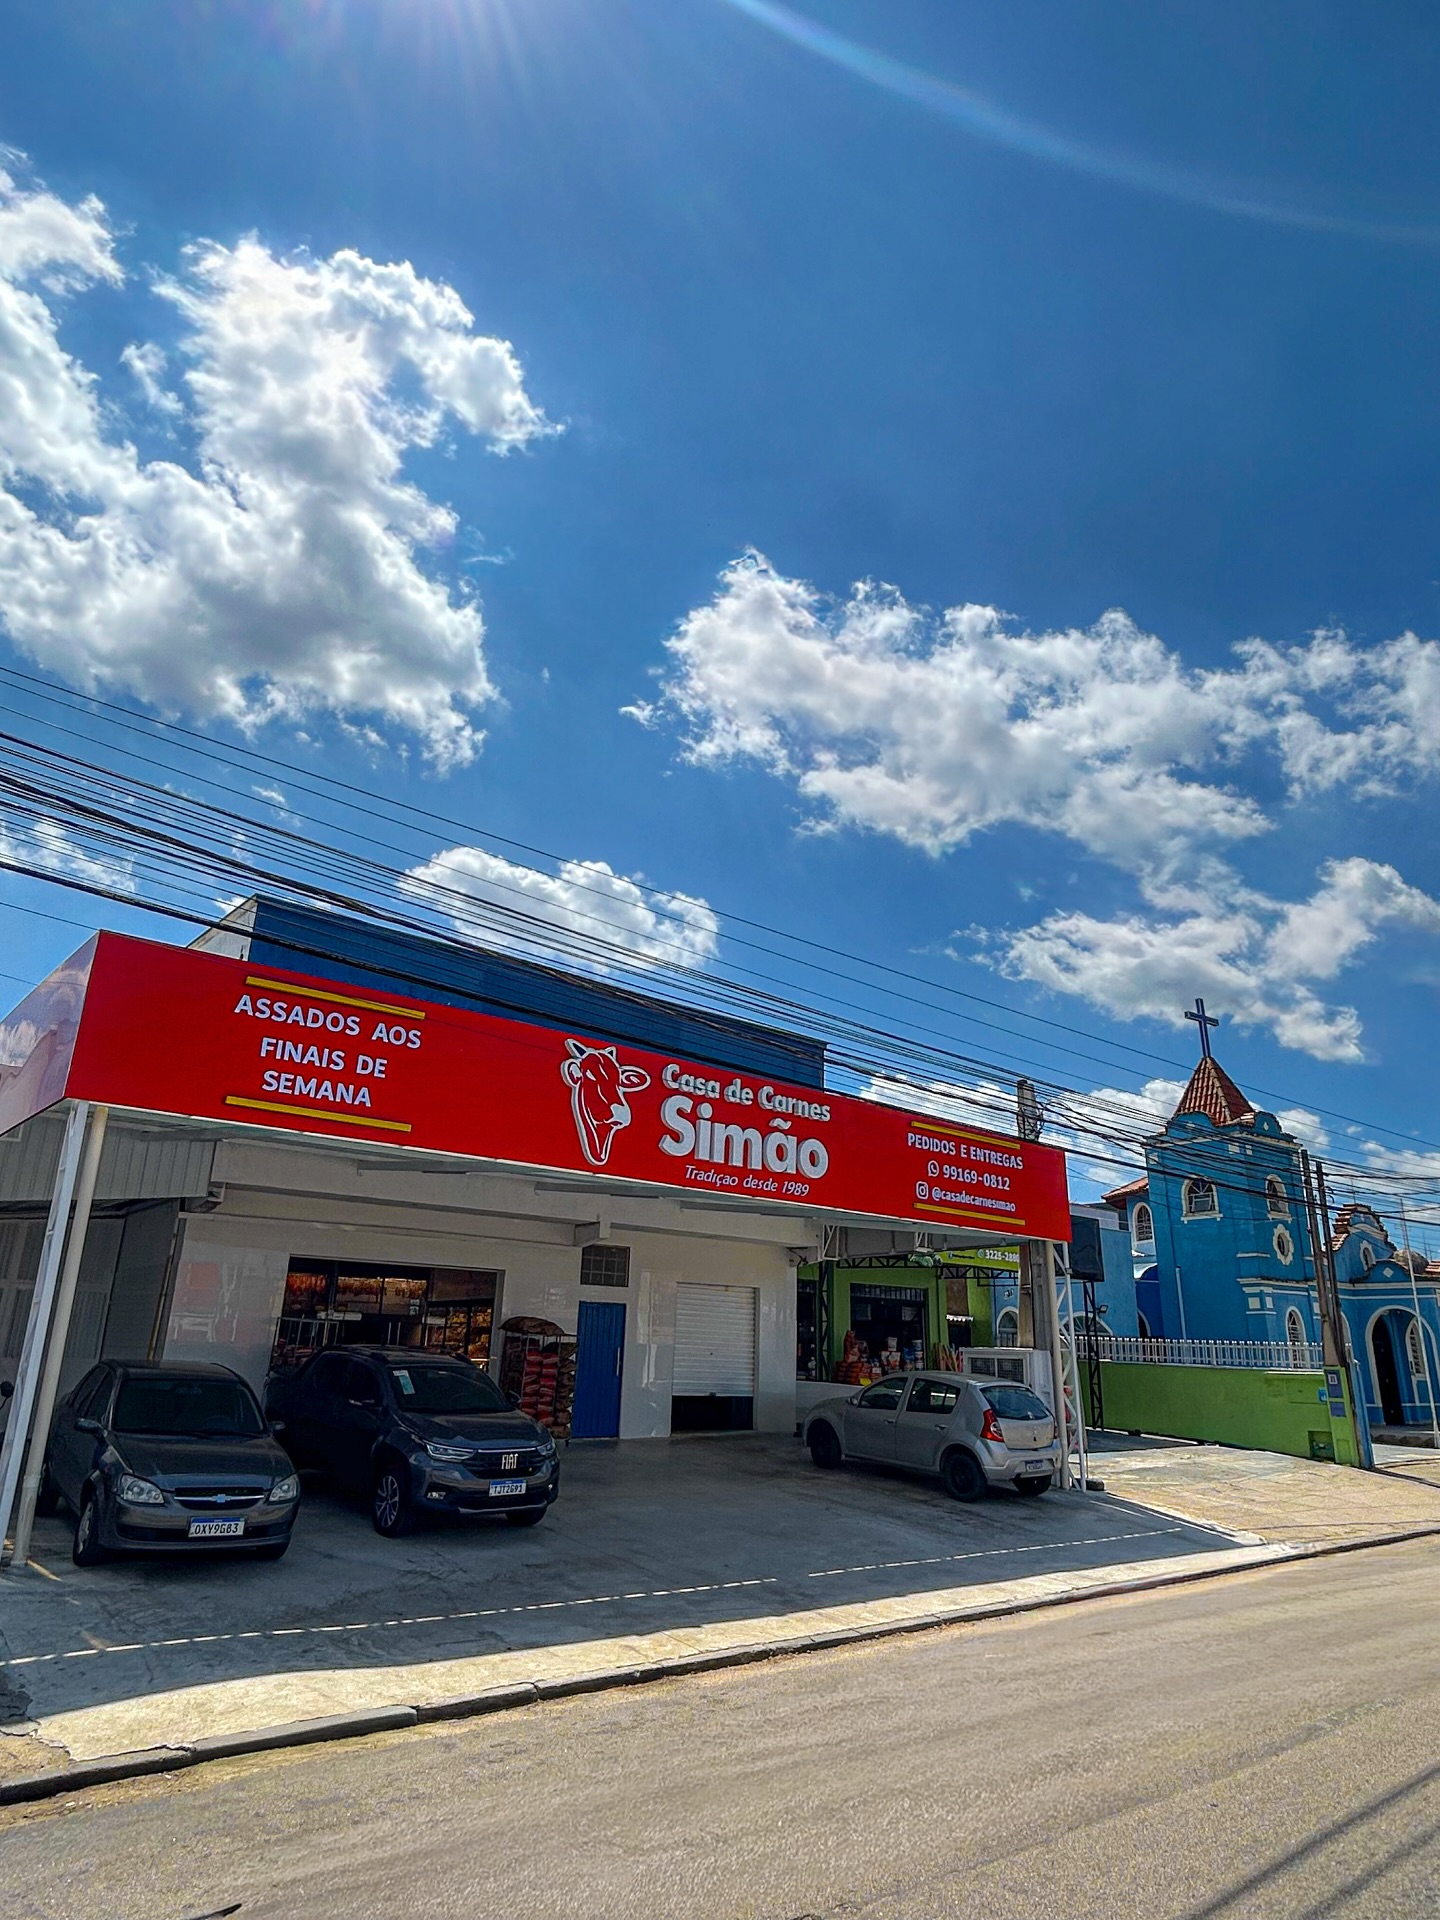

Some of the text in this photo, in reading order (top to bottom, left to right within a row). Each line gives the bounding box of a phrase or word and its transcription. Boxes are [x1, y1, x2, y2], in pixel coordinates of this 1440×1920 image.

[234, 994, 422, 1049] ASSADOS AOS
[260, 1037, 388, 1078] FINAIS DE
[261, 1070, 372, 1107] SEMANA
[662, 1063, 831, 1122] Casa de Carnes
[658, 1094, 829, 1179] Simão
[907, 1132, 1024, 1170] PEDIDOS E ENTREGAS
[743, 1174, 778, 1192] desde
[781, 1180, 810, 1197] 1989
[942, 1164, 1011, 1191] 99169-0812
[501, 1453, 519, 1470] FIAT
